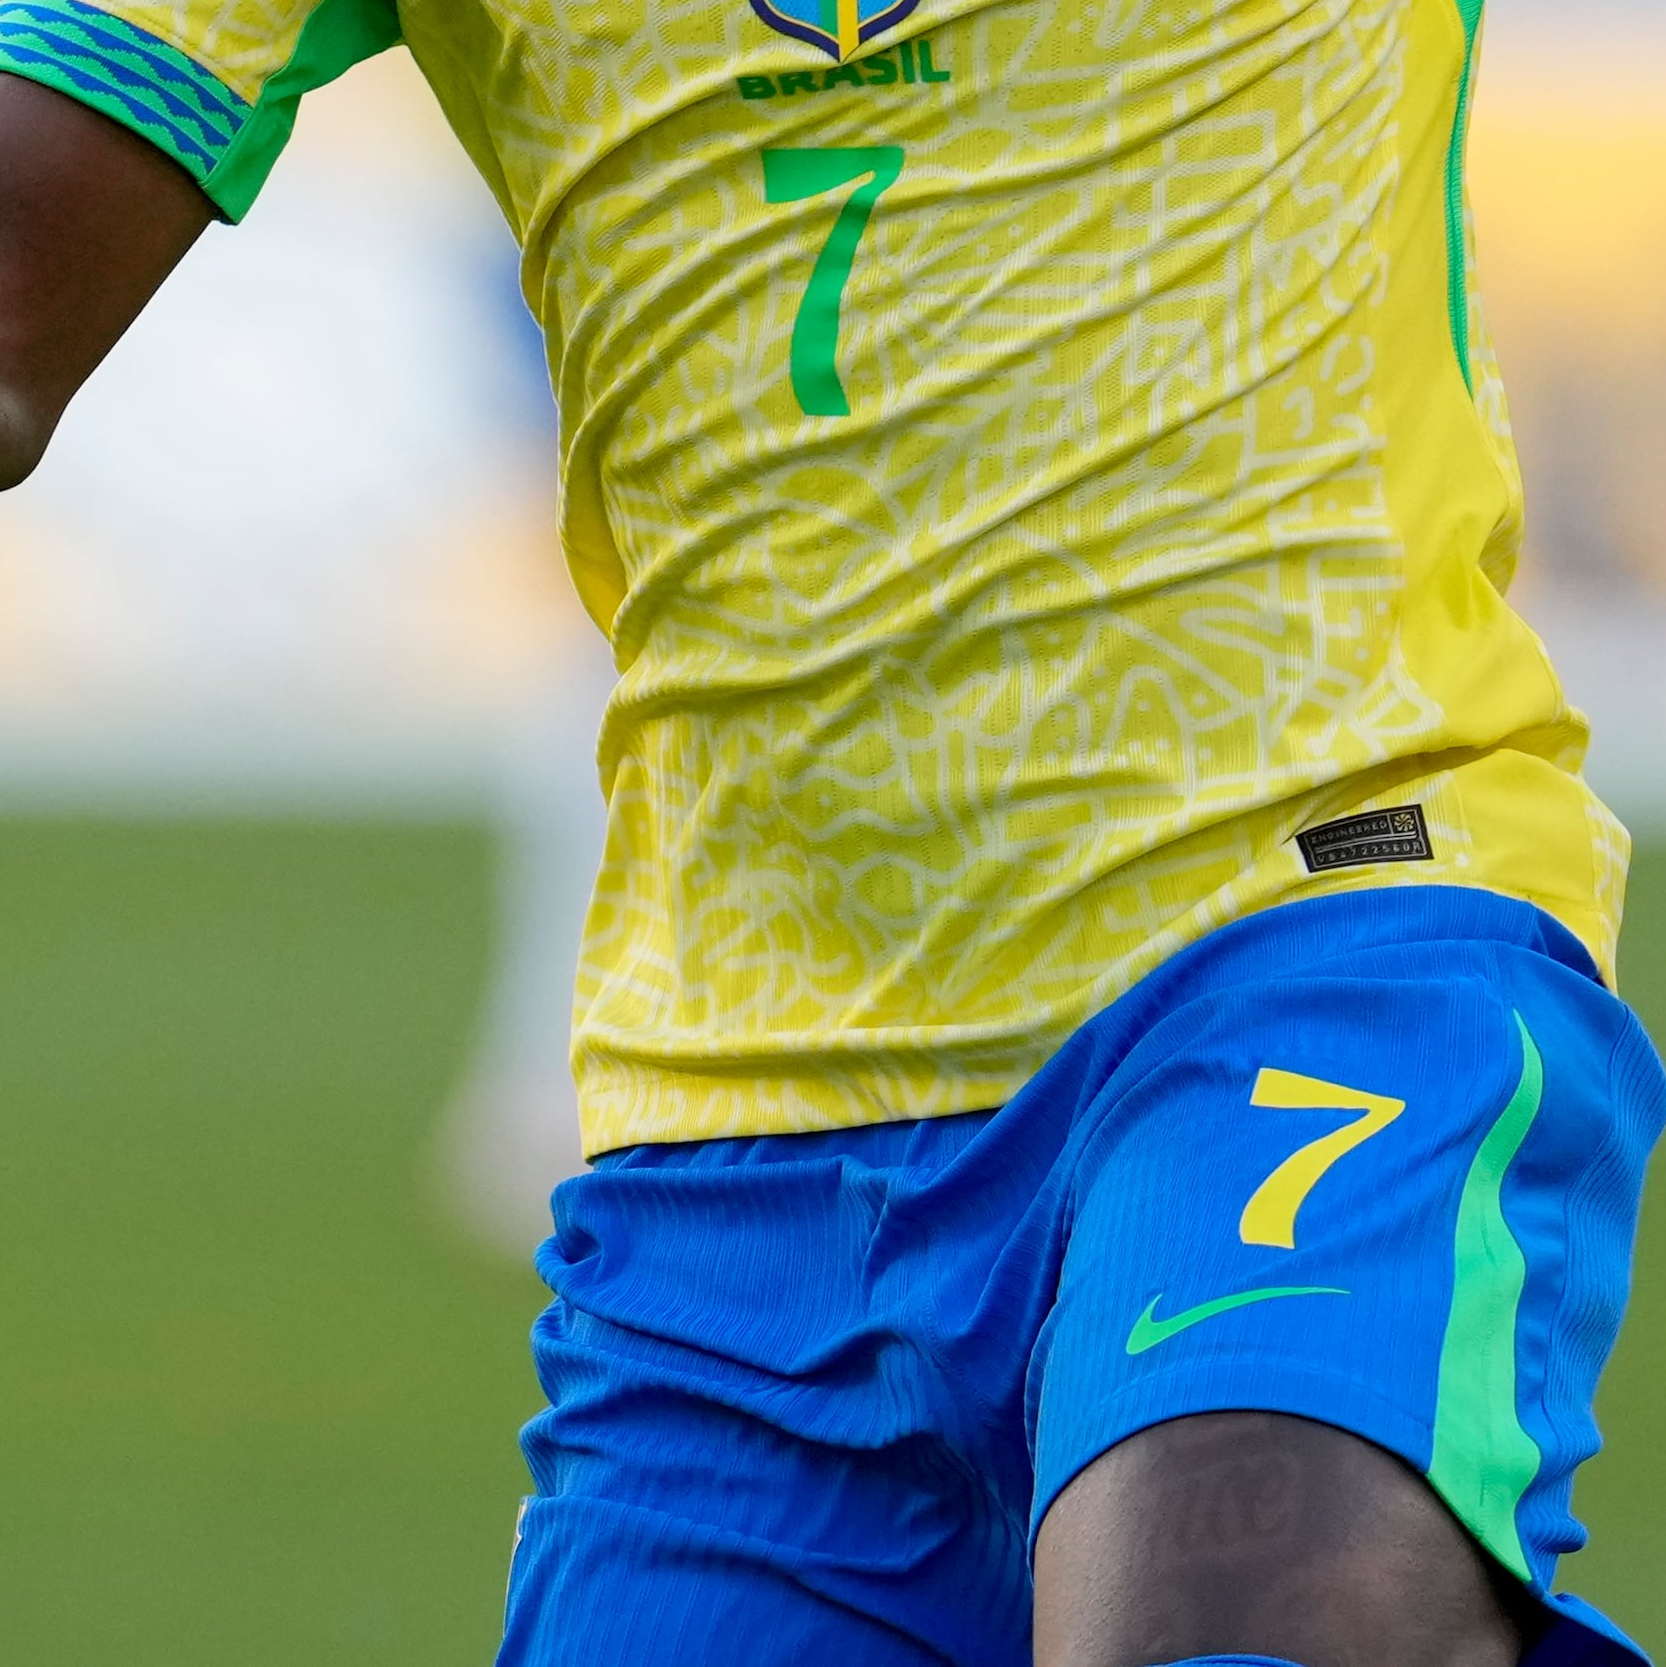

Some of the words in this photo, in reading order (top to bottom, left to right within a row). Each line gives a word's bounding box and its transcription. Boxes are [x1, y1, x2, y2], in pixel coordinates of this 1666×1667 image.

[737, 40, 950, 100] BRASIL
[762, 146, 904, 417] 7
[1240, 1068, 1406, 1249] 7
